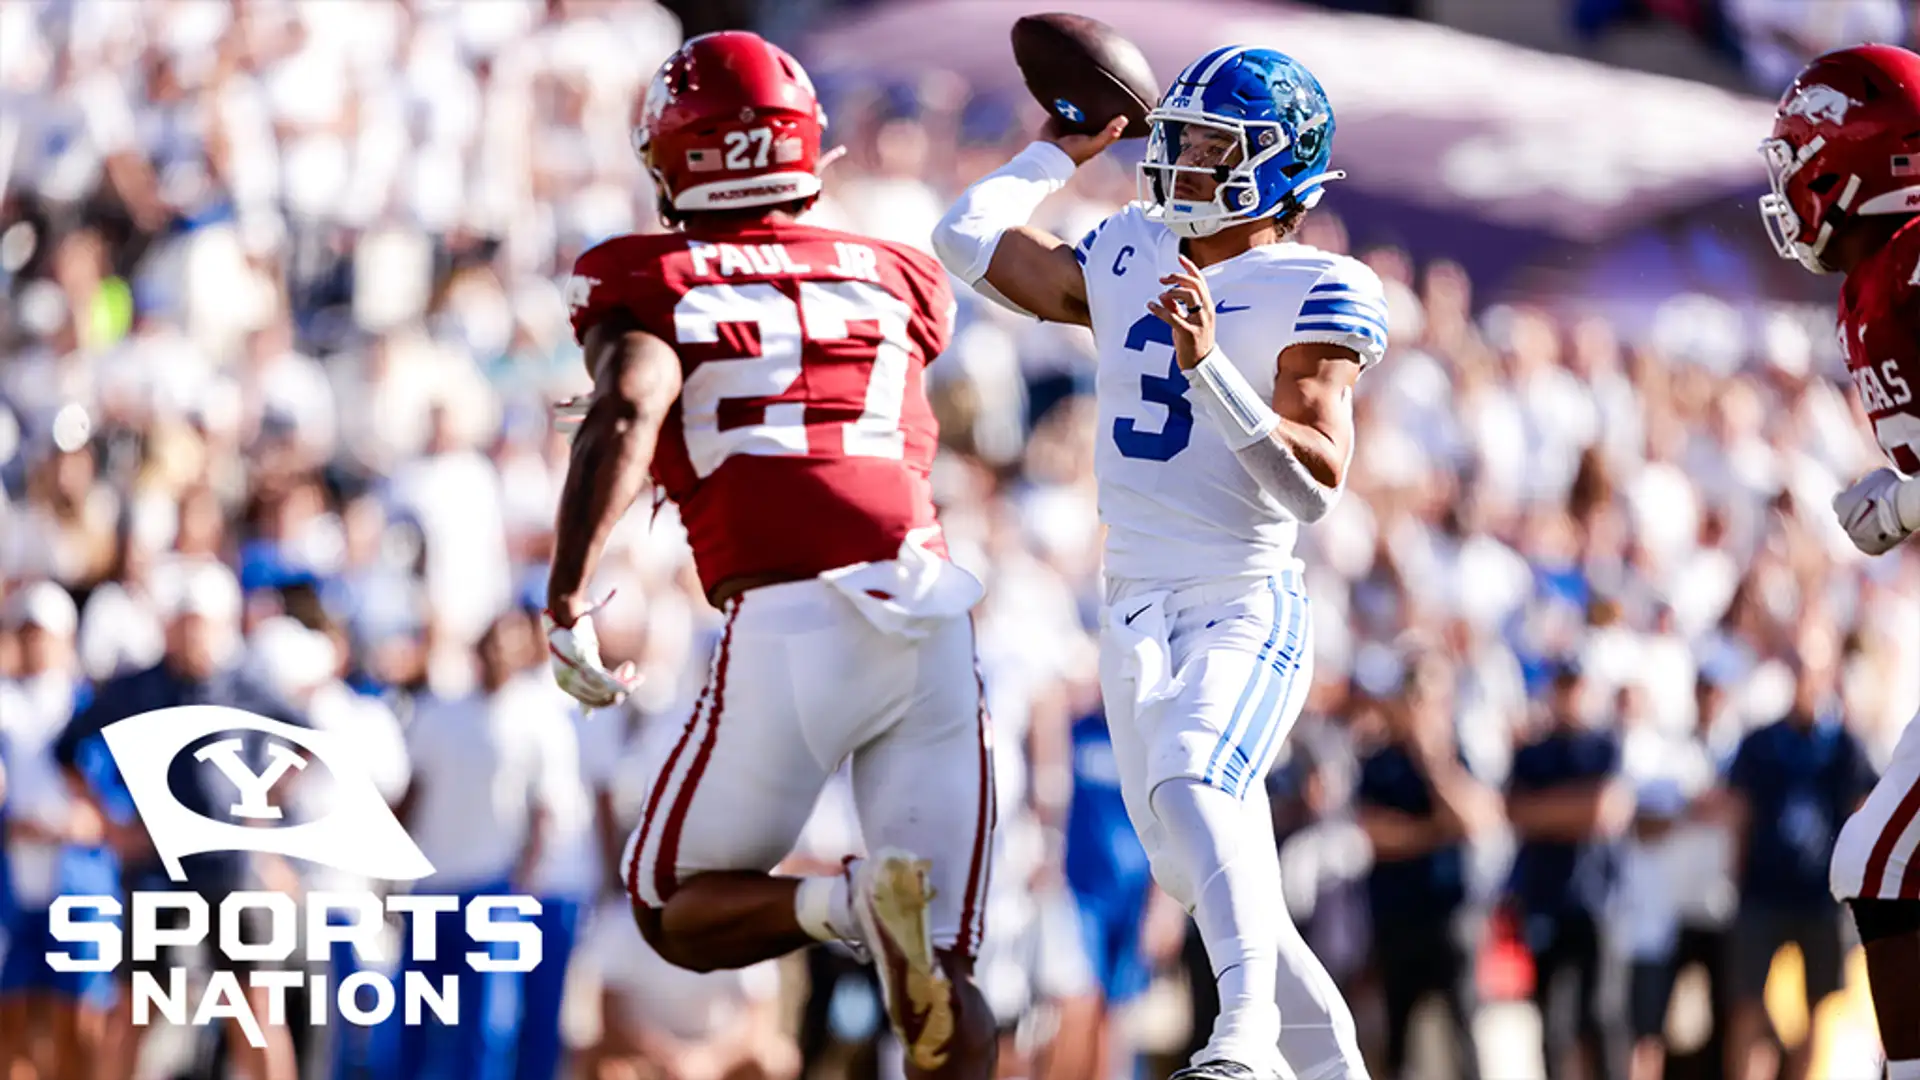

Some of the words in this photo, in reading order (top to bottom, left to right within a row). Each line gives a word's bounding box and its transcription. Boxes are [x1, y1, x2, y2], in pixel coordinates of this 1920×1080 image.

[724, 127, 773, 170] 27
[687, 239, 811, 277] PAUL
[828, 241, 880, 282] JR
[1112, 245, 1135, 276] C
[673, 281, 913, 479] 27
[1113, 313, 1194, 463] 3
